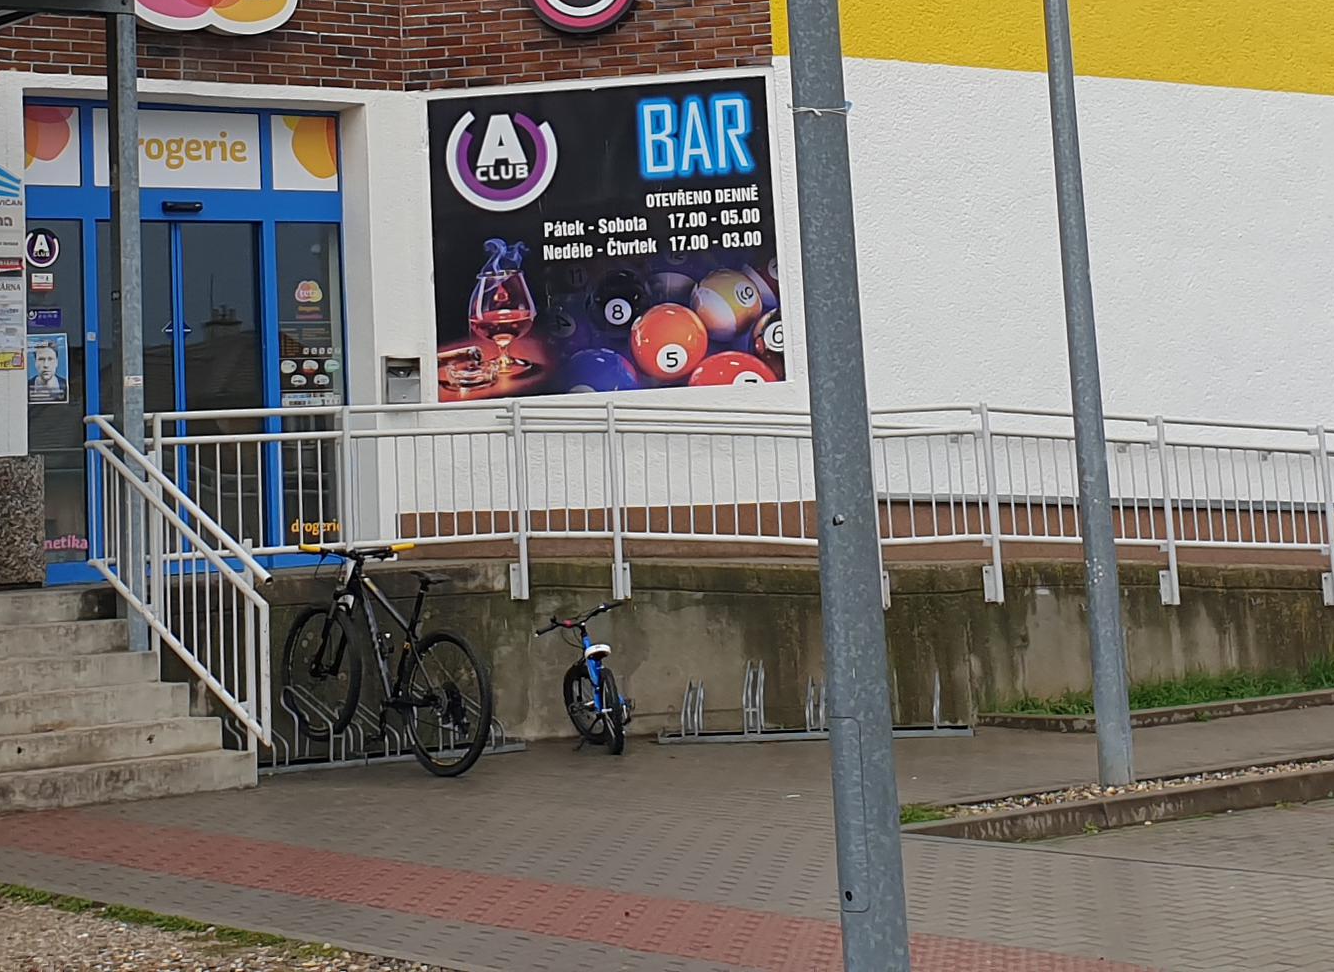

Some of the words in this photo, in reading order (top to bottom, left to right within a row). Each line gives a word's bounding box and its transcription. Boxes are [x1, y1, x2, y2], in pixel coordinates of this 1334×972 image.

[476, 114, 528, 167] A
[640, 94, 753, 176] BAR
[475, 164, 530, 182] CLUB
[646, 188, 712, 209] OTEVŘENO
[714, 185, 759, 204] DENNĚ
[543, 219, 585, 238] Pátek
[598, 215, 648, 235] Sobota
[668, 211, 707, 229] 17.00
[720, 208, 760, 226] 05.00
[543, 242, 593, 261] Neděle
[607, 236, 657, 257] Čtvrtek
[669, 234, 708, 252] 17.00
[721, 231, 762, 248] 03.00
[612, 304, 623, 320] 8
[666, 352, 679, 368] 5
